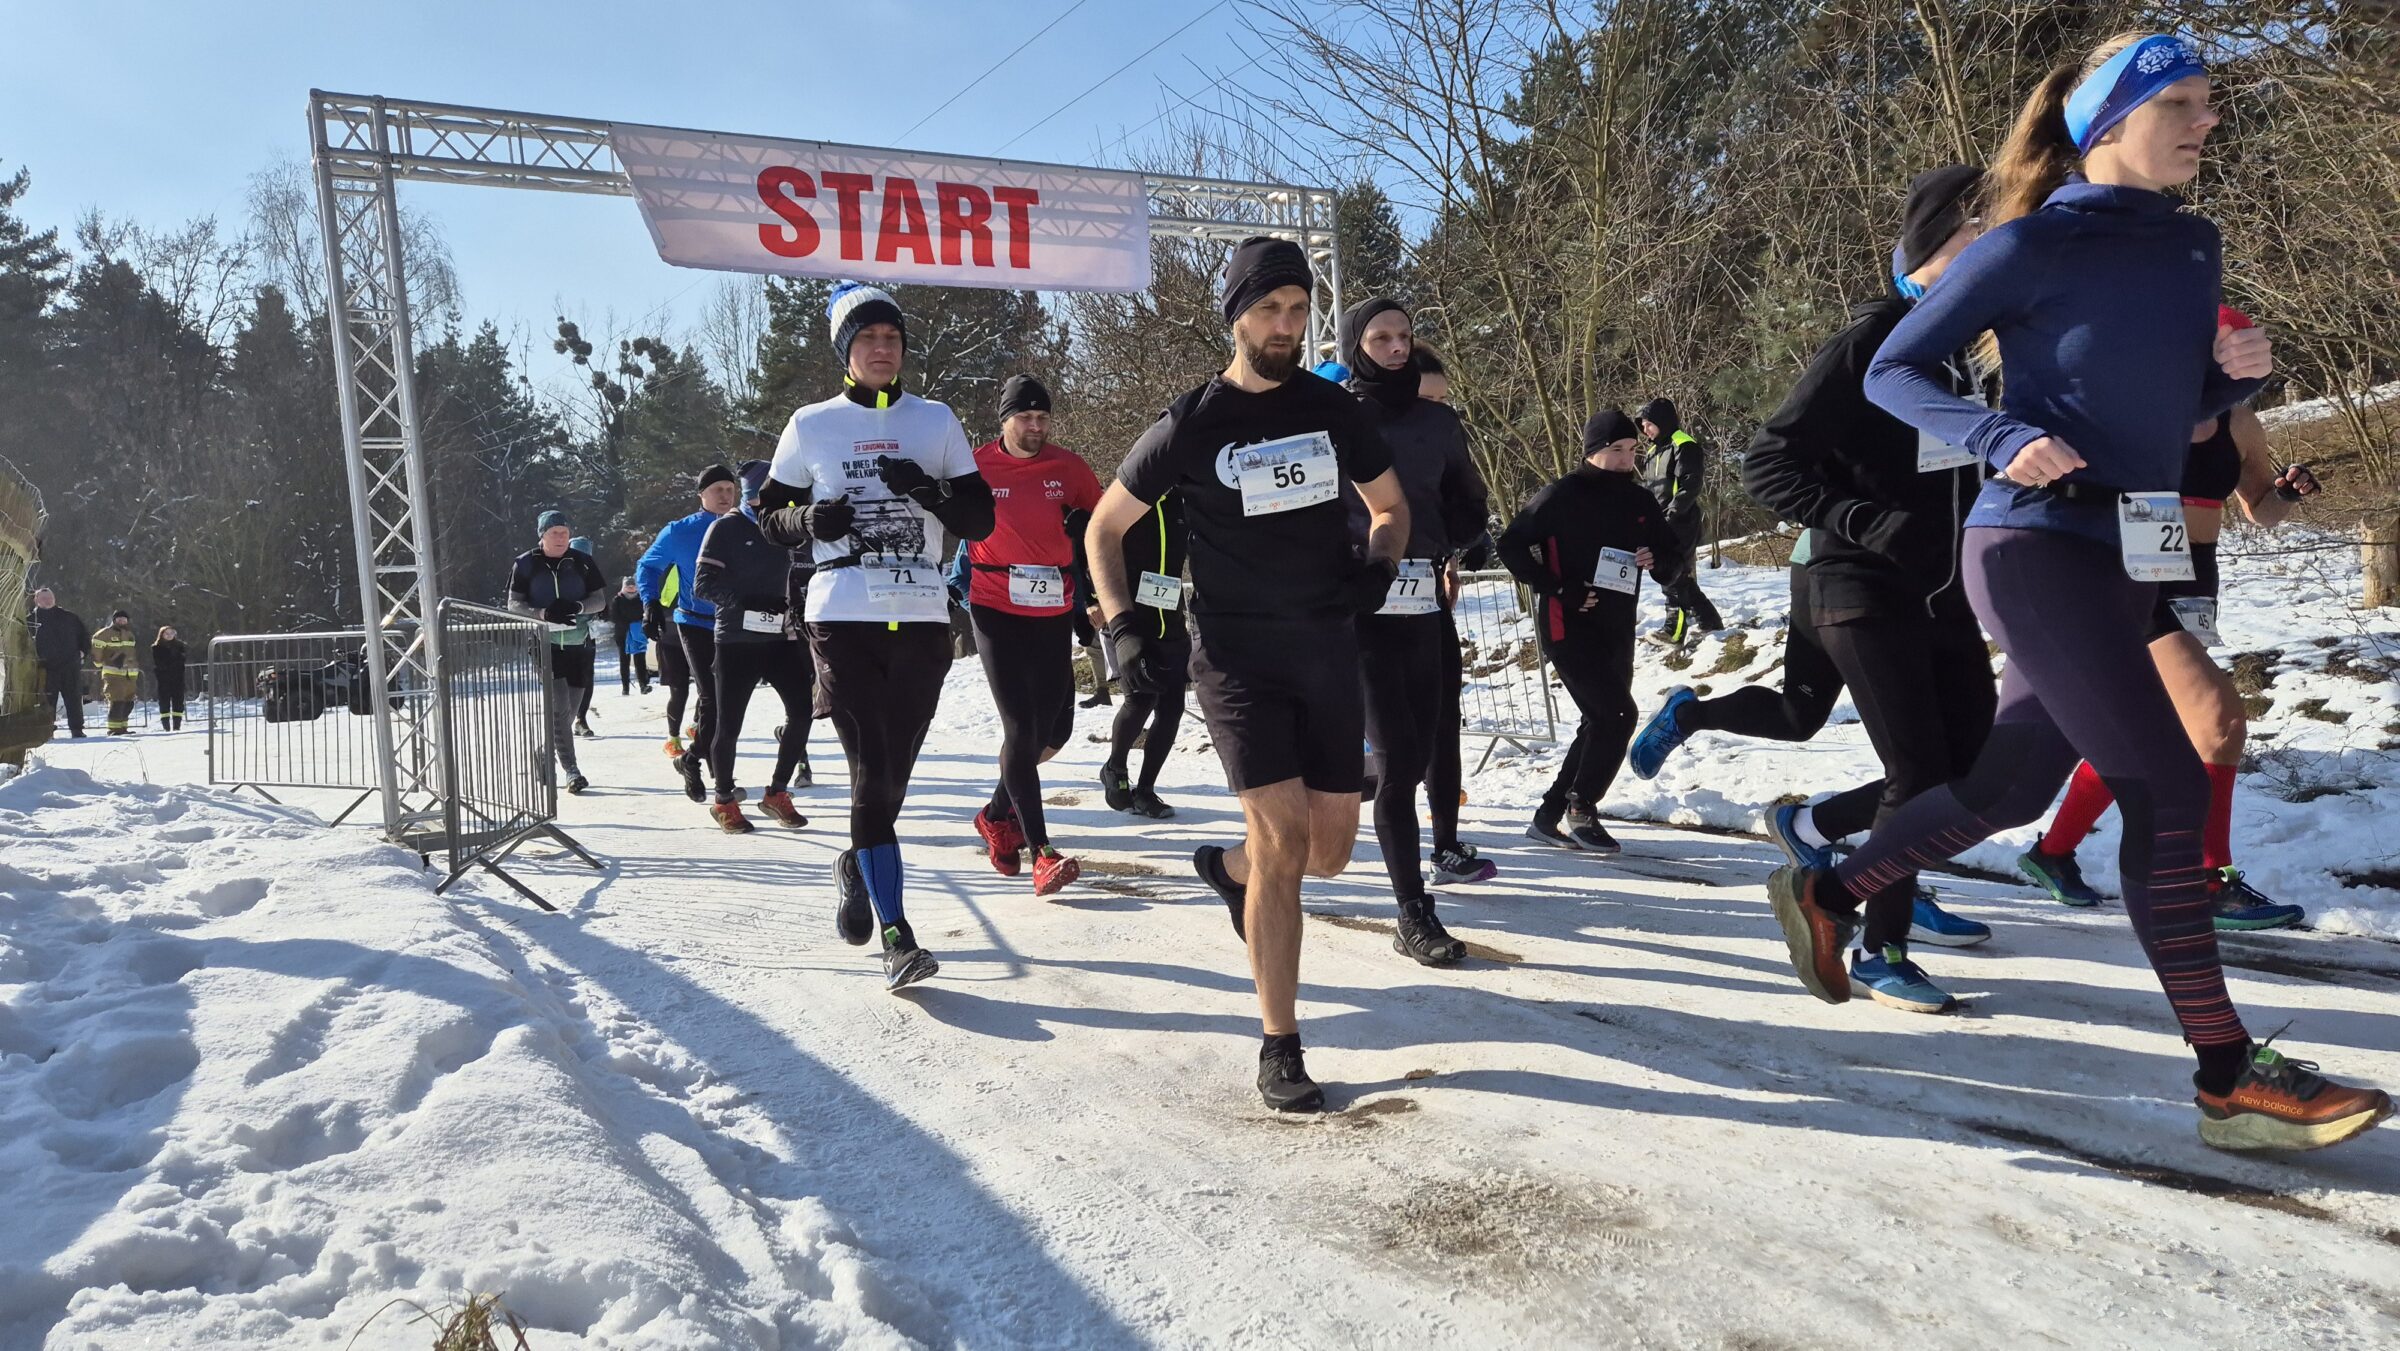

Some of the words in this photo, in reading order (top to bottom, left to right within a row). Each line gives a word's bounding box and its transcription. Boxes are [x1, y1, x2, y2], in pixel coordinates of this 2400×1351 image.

[757, 166, 1039, 269] START
[842, 461, 850, 470] IV
[852, 459, 870, 469] BIEG
[1273, 462, 1306, 489] 56
[1045, 490, 1064, 498] club
[2160, 524, 2184, 552] 22
[889, 569, 916, 584] 71
[1620, 566, 1628, 578] 6
[1030, 580, 1047, 594] 73
[1153, 586, 1168, 598] 17
[1397, 579, 1419, 596] 77
[760, 613, 774, 622] 35
[2198, 614, 2210, 630] 45
[2239, 1095, 2261, 1107] new
[2263, 1097, 2304, 1115] balance
